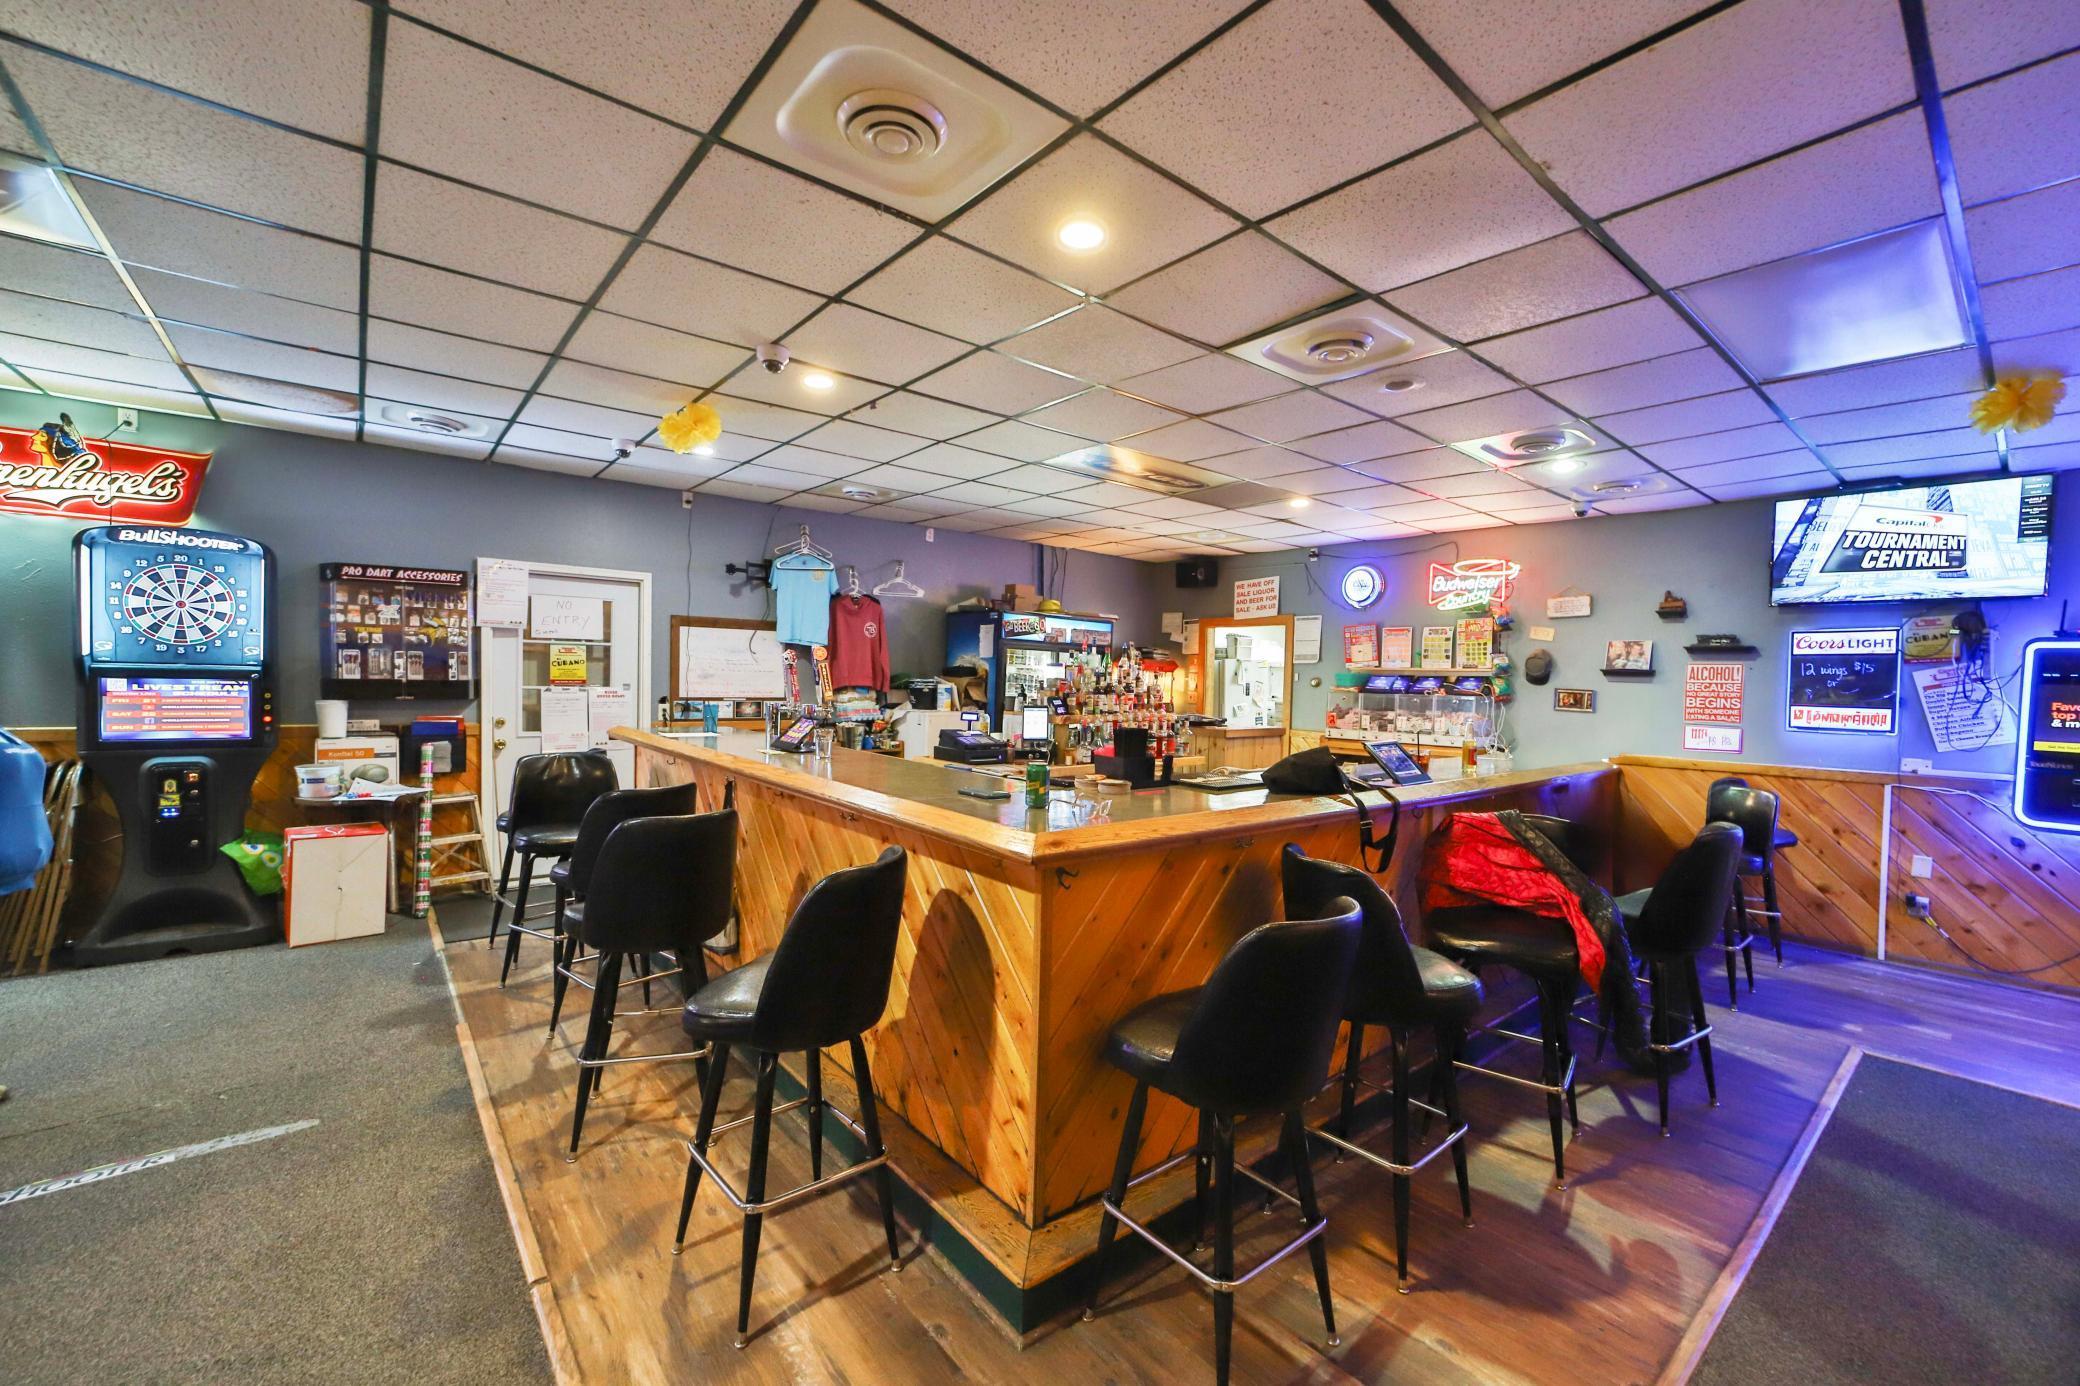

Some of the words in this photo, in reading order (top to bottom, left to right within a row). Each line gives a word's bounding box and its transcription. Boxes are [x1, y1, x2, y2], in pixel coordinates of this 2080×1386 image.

[1841, 530, 1967, 550] TOURNAMENT
[135, 559, 148, 567] 12
[156, 555, 165, 563] 5
[173, 554, 188, 563] 20
[197, 558, 204, 566] 1
[1860, 549, 1950, 569] CENTRAL
[123, 569, 132, 577] 9
[341, 566, 363, 576] PRO
[365, 567, 394, 578] DART
[396, 570, 464, 583] ACCESSORIES
[228, 577, 236, 585] 4
[1247, 581, 1262, 589] HAVE
[1263, 579, 1275, 587] OFF
[1236, 590, 1251, 598] SALE
[1252, 587, 1275, 596] LIQUOR
[1248, 596, 1264, 604] BEER
[1265, 594, 1277, 602] FOR
[556, 599, 574, 609] NO
[541, 615, 592, 631] ENTRY
[137, 637, 146, 645] 7
[214, 639, 222, 647] 2
[1796, 635, 1845, 650] Coors
[1847, 638, 1894, 649] LIGHT
[155, 643, 168, 652] 19
[195, 645, 207, 653] 17
[551, 659, 585, 667] CUBANO
[1688, 666, 1741, 681] ALCOHOL!
[1801, 662, 1816, 676] 12
[1820, 664, 1848, 681] wings
[131, 683, 250, 692] LIVESTREAM
[1686, 683, 1741, 692] BECAUSE
[1685, 697, 1741, 709] BEGINS
[2051, 711, 2077, 721] top
[2051, 719, 2063, 728] &
